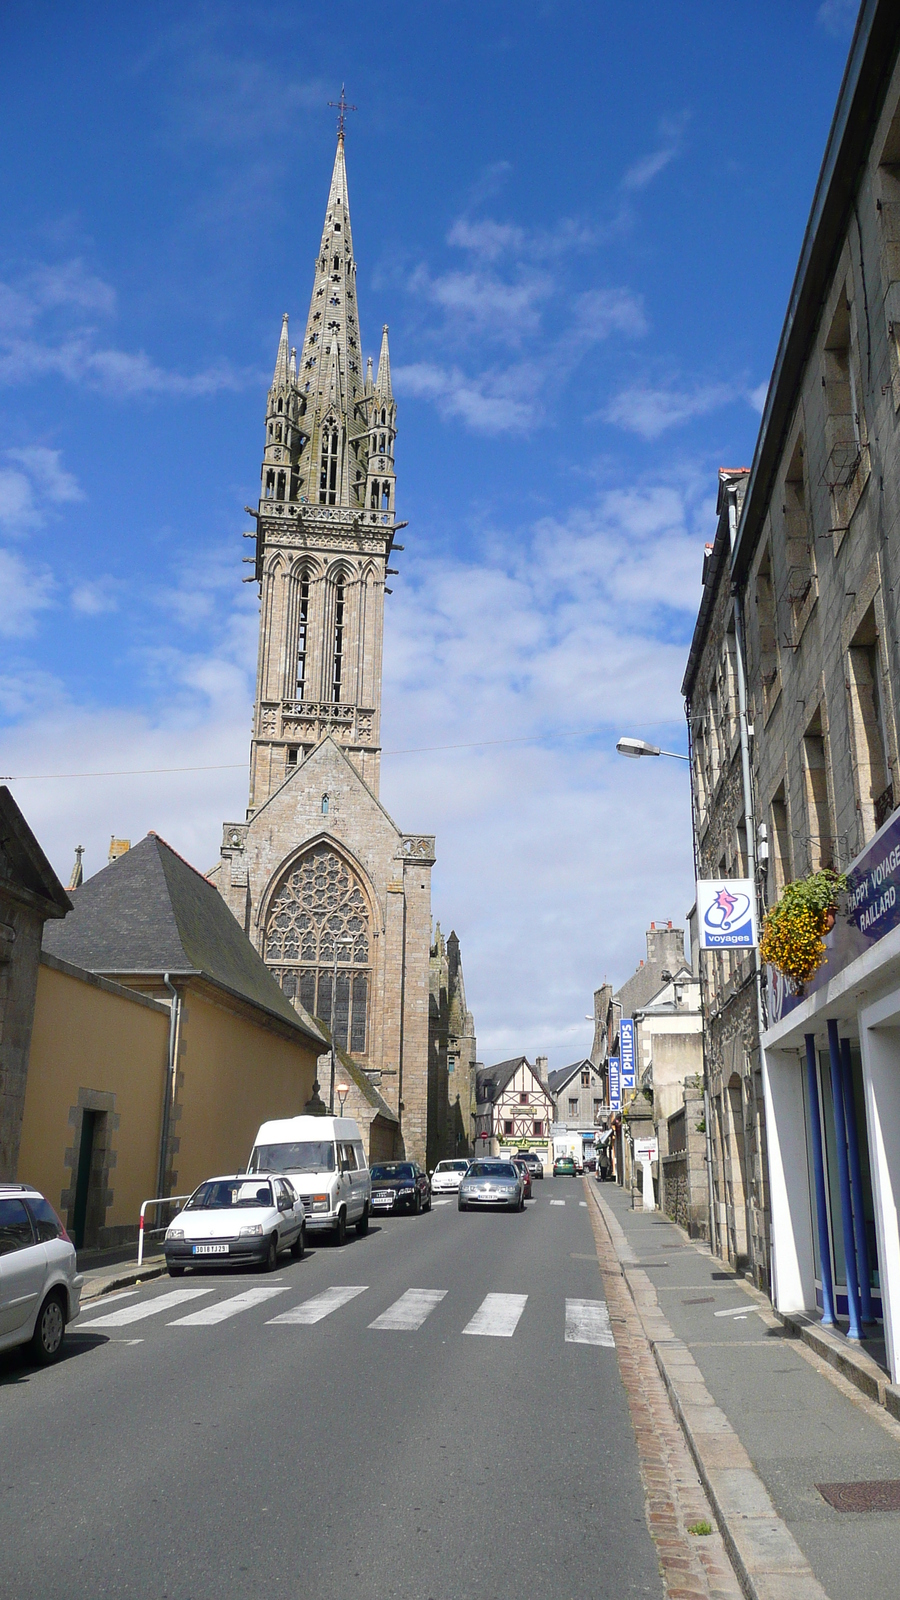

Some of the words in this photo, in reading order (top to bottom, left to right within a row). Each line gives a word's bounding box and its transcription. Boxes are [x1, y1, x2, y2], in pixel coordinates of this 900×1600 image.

[848, 878, 869, 914] HAPPY
[859, 886, 896, 933] RAILLARD
[708, 935, 750, 944] voyages
[621, 1024, 633, 1070] PHILIPS
[610, 1061, 619, 1098] PHILIPS
